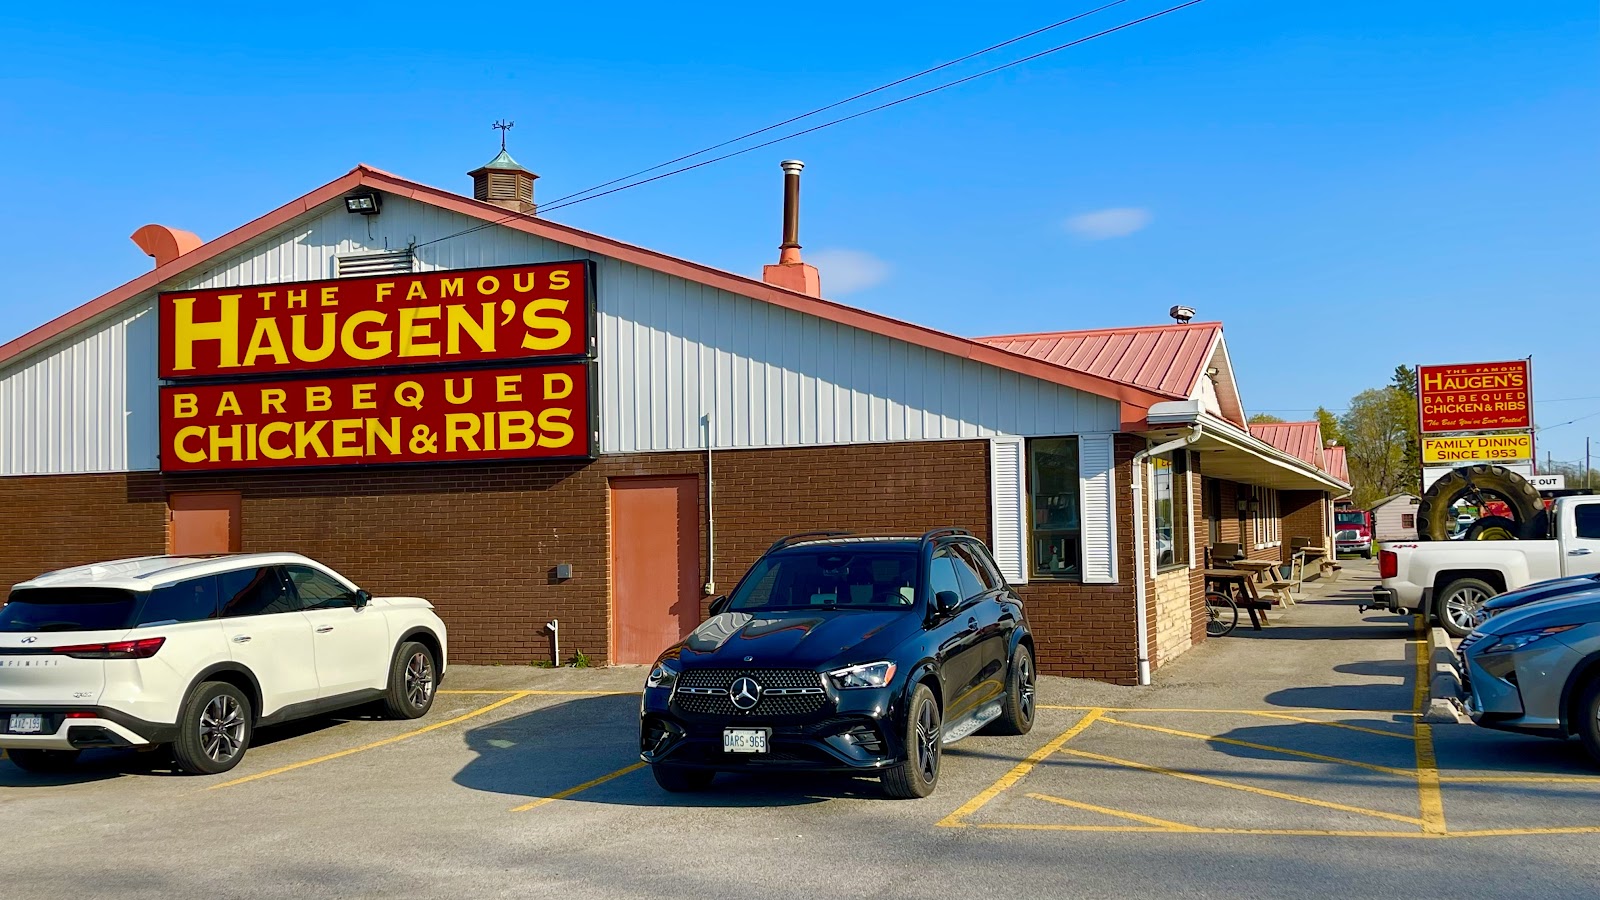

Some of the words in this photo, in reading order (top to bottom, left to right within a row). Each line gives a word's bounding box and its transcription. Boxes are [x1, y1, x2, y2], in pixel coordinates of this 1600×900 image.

[258, 286, 339, 311] THE
[376, 270, 570, 303] FAMOUS
[172, 294, 572, 371] HAUGEN'S
[1424, 372, 1524, 391] HAUGEN'S
[173, 372, 574, 419] BARBEQUED
[1424, 392, 1526, 404] BARBEQUED
[1424, 403, 1483, 414] CHICKEN
[1484, 403, 1493, 412] &
[1495, 401, 1526, 411] RIBS
[173, 416, 402, 464] CHICKEN
[408, 423, 438, 455] &
[444, 407, 575, 453] RIBS
[1426, 439, 1474, 449] FAMILY
[1478, 437, 1528, 448] DINING
[1437, 450, 1480, 460] SINCE
[1485, 449, 1517, 458] 1953
[1539, 478, 1557, 486] OUT
[749, 735, 765, 748] 965
